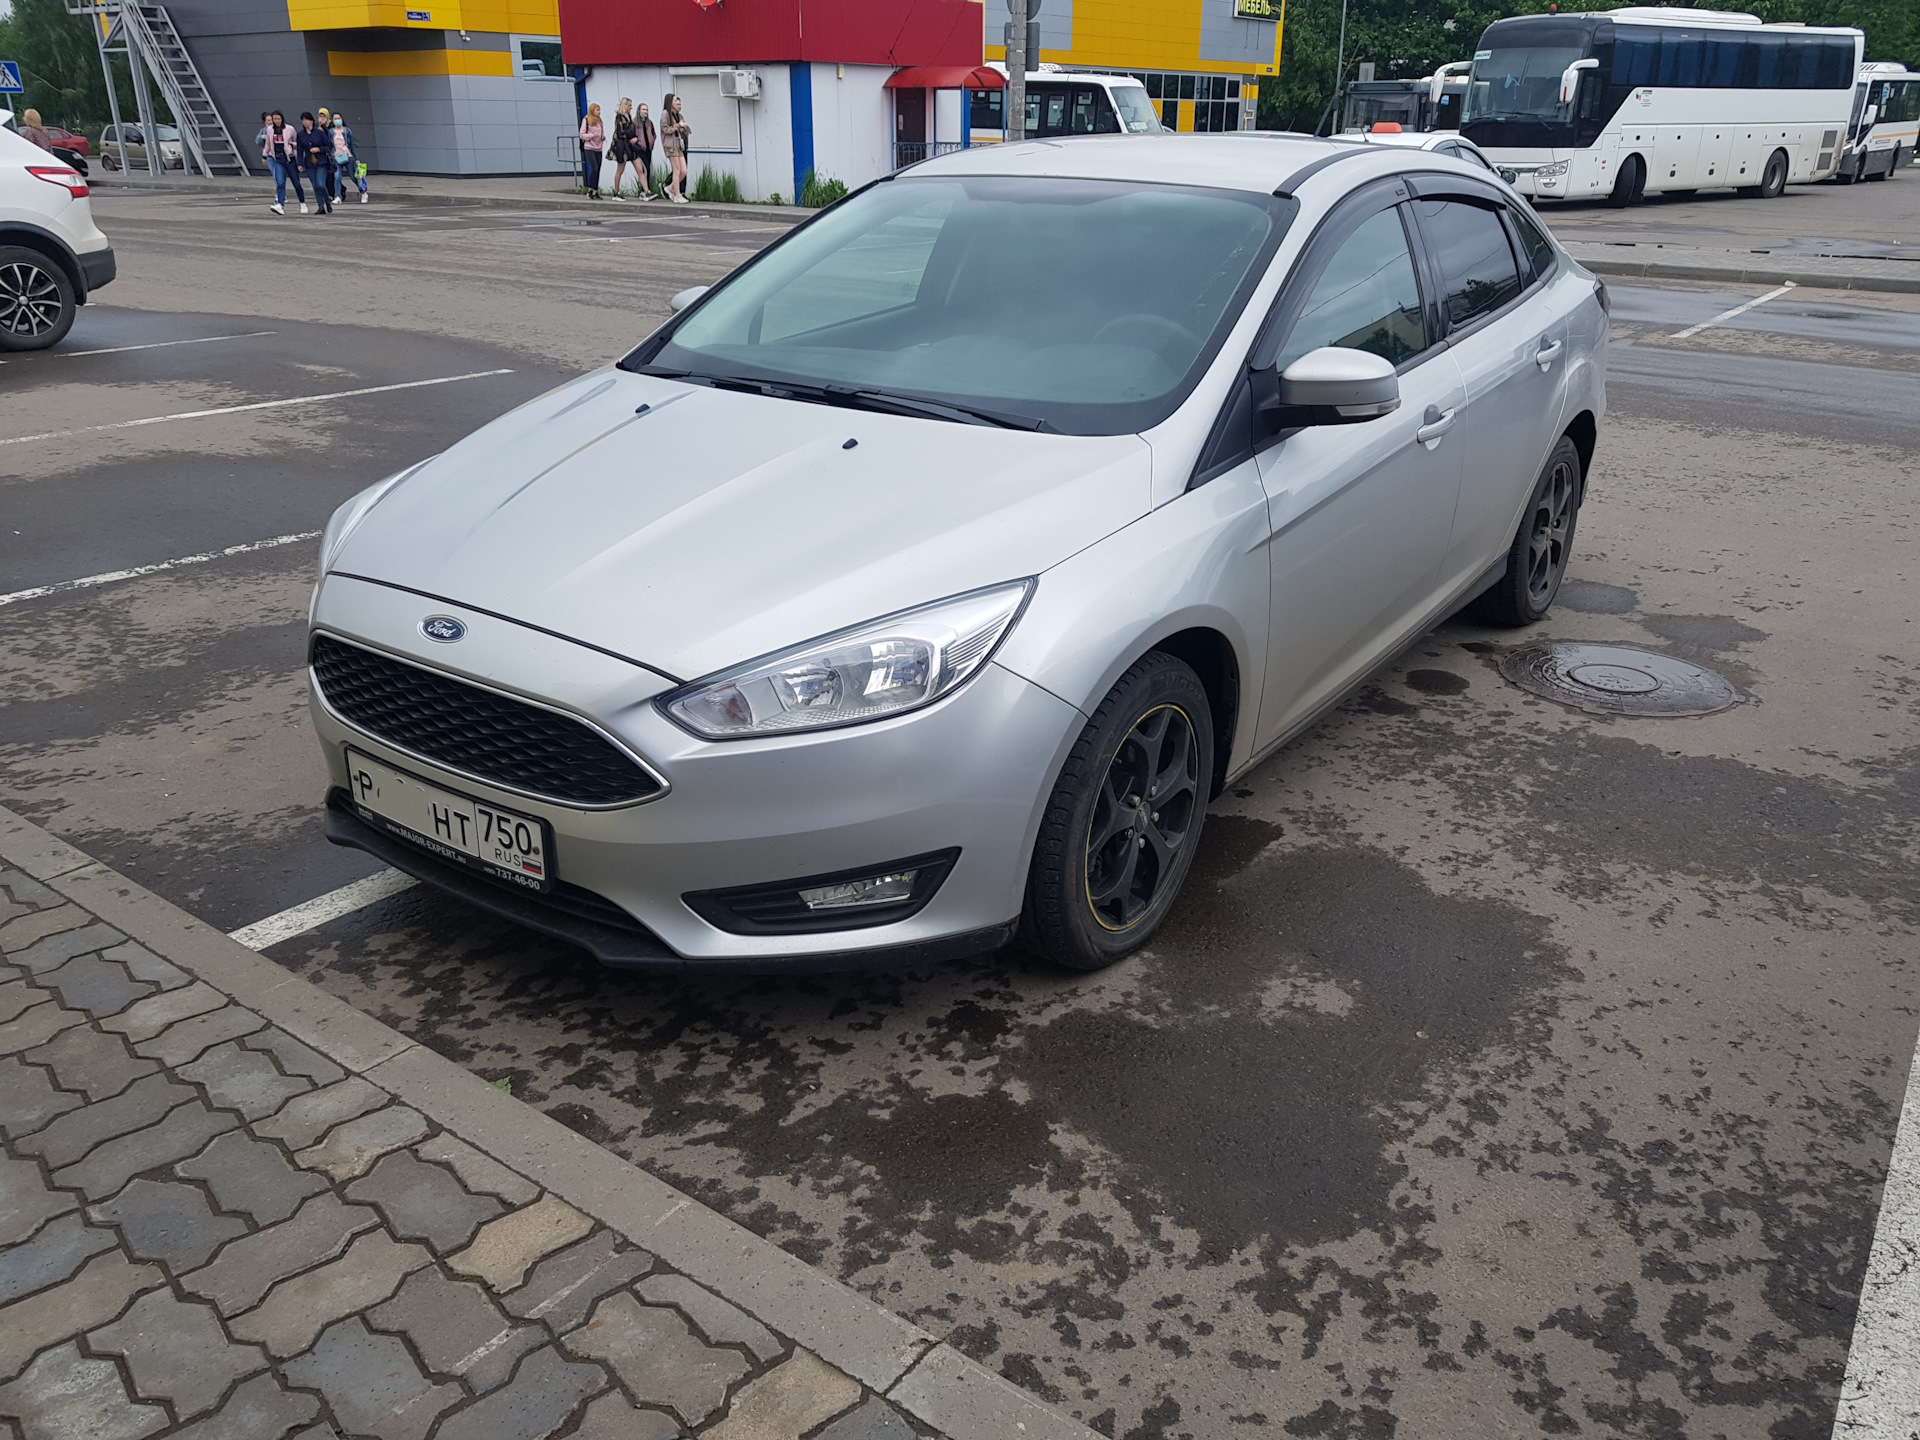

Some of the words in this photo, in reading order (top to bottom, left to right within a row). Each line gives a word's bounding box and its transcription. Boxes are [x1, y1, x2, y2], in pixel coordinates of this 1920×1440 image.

[1238, 0, 1271, 15] МЕБЕЛЬ
[427, 620, 457, 637] Ford
[478, 807, 532, 855] 750
[495, 848, 521, 866] RUS
